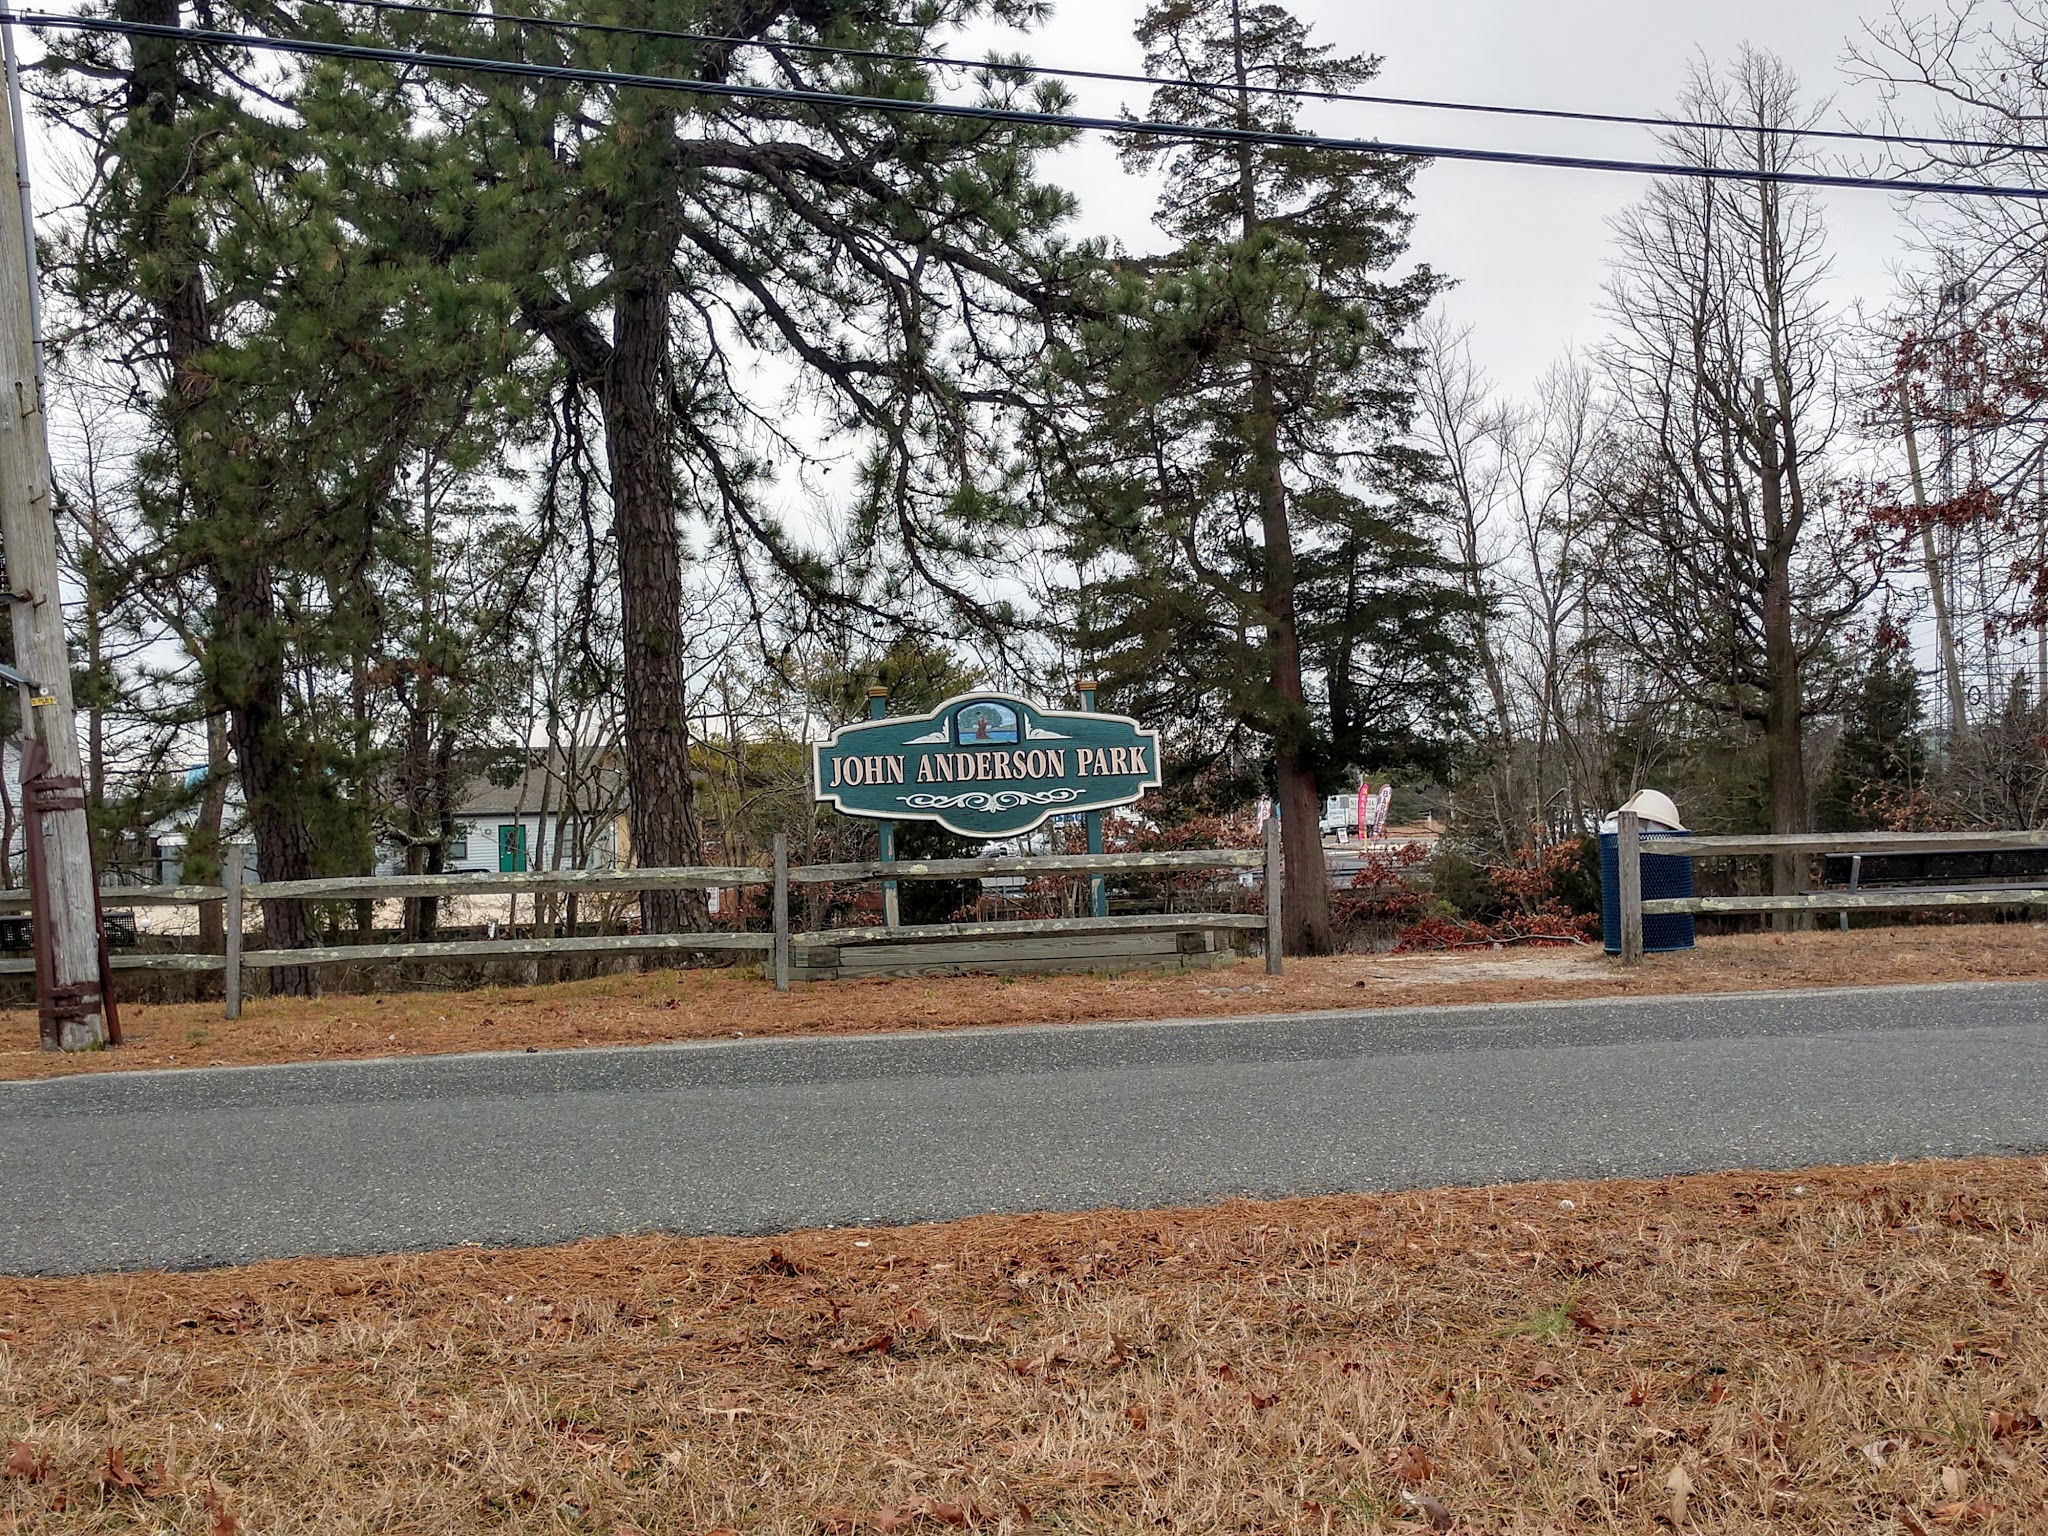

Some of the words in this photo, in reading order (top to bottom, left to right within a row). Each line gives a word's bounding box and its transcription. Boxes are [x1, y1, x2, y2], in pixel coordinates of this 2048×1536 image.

[829, 755, 906, 788] JOHN
[916, 749, 1065, 783] ANDERSON
[1076, 746, 1149, 777] PARK
